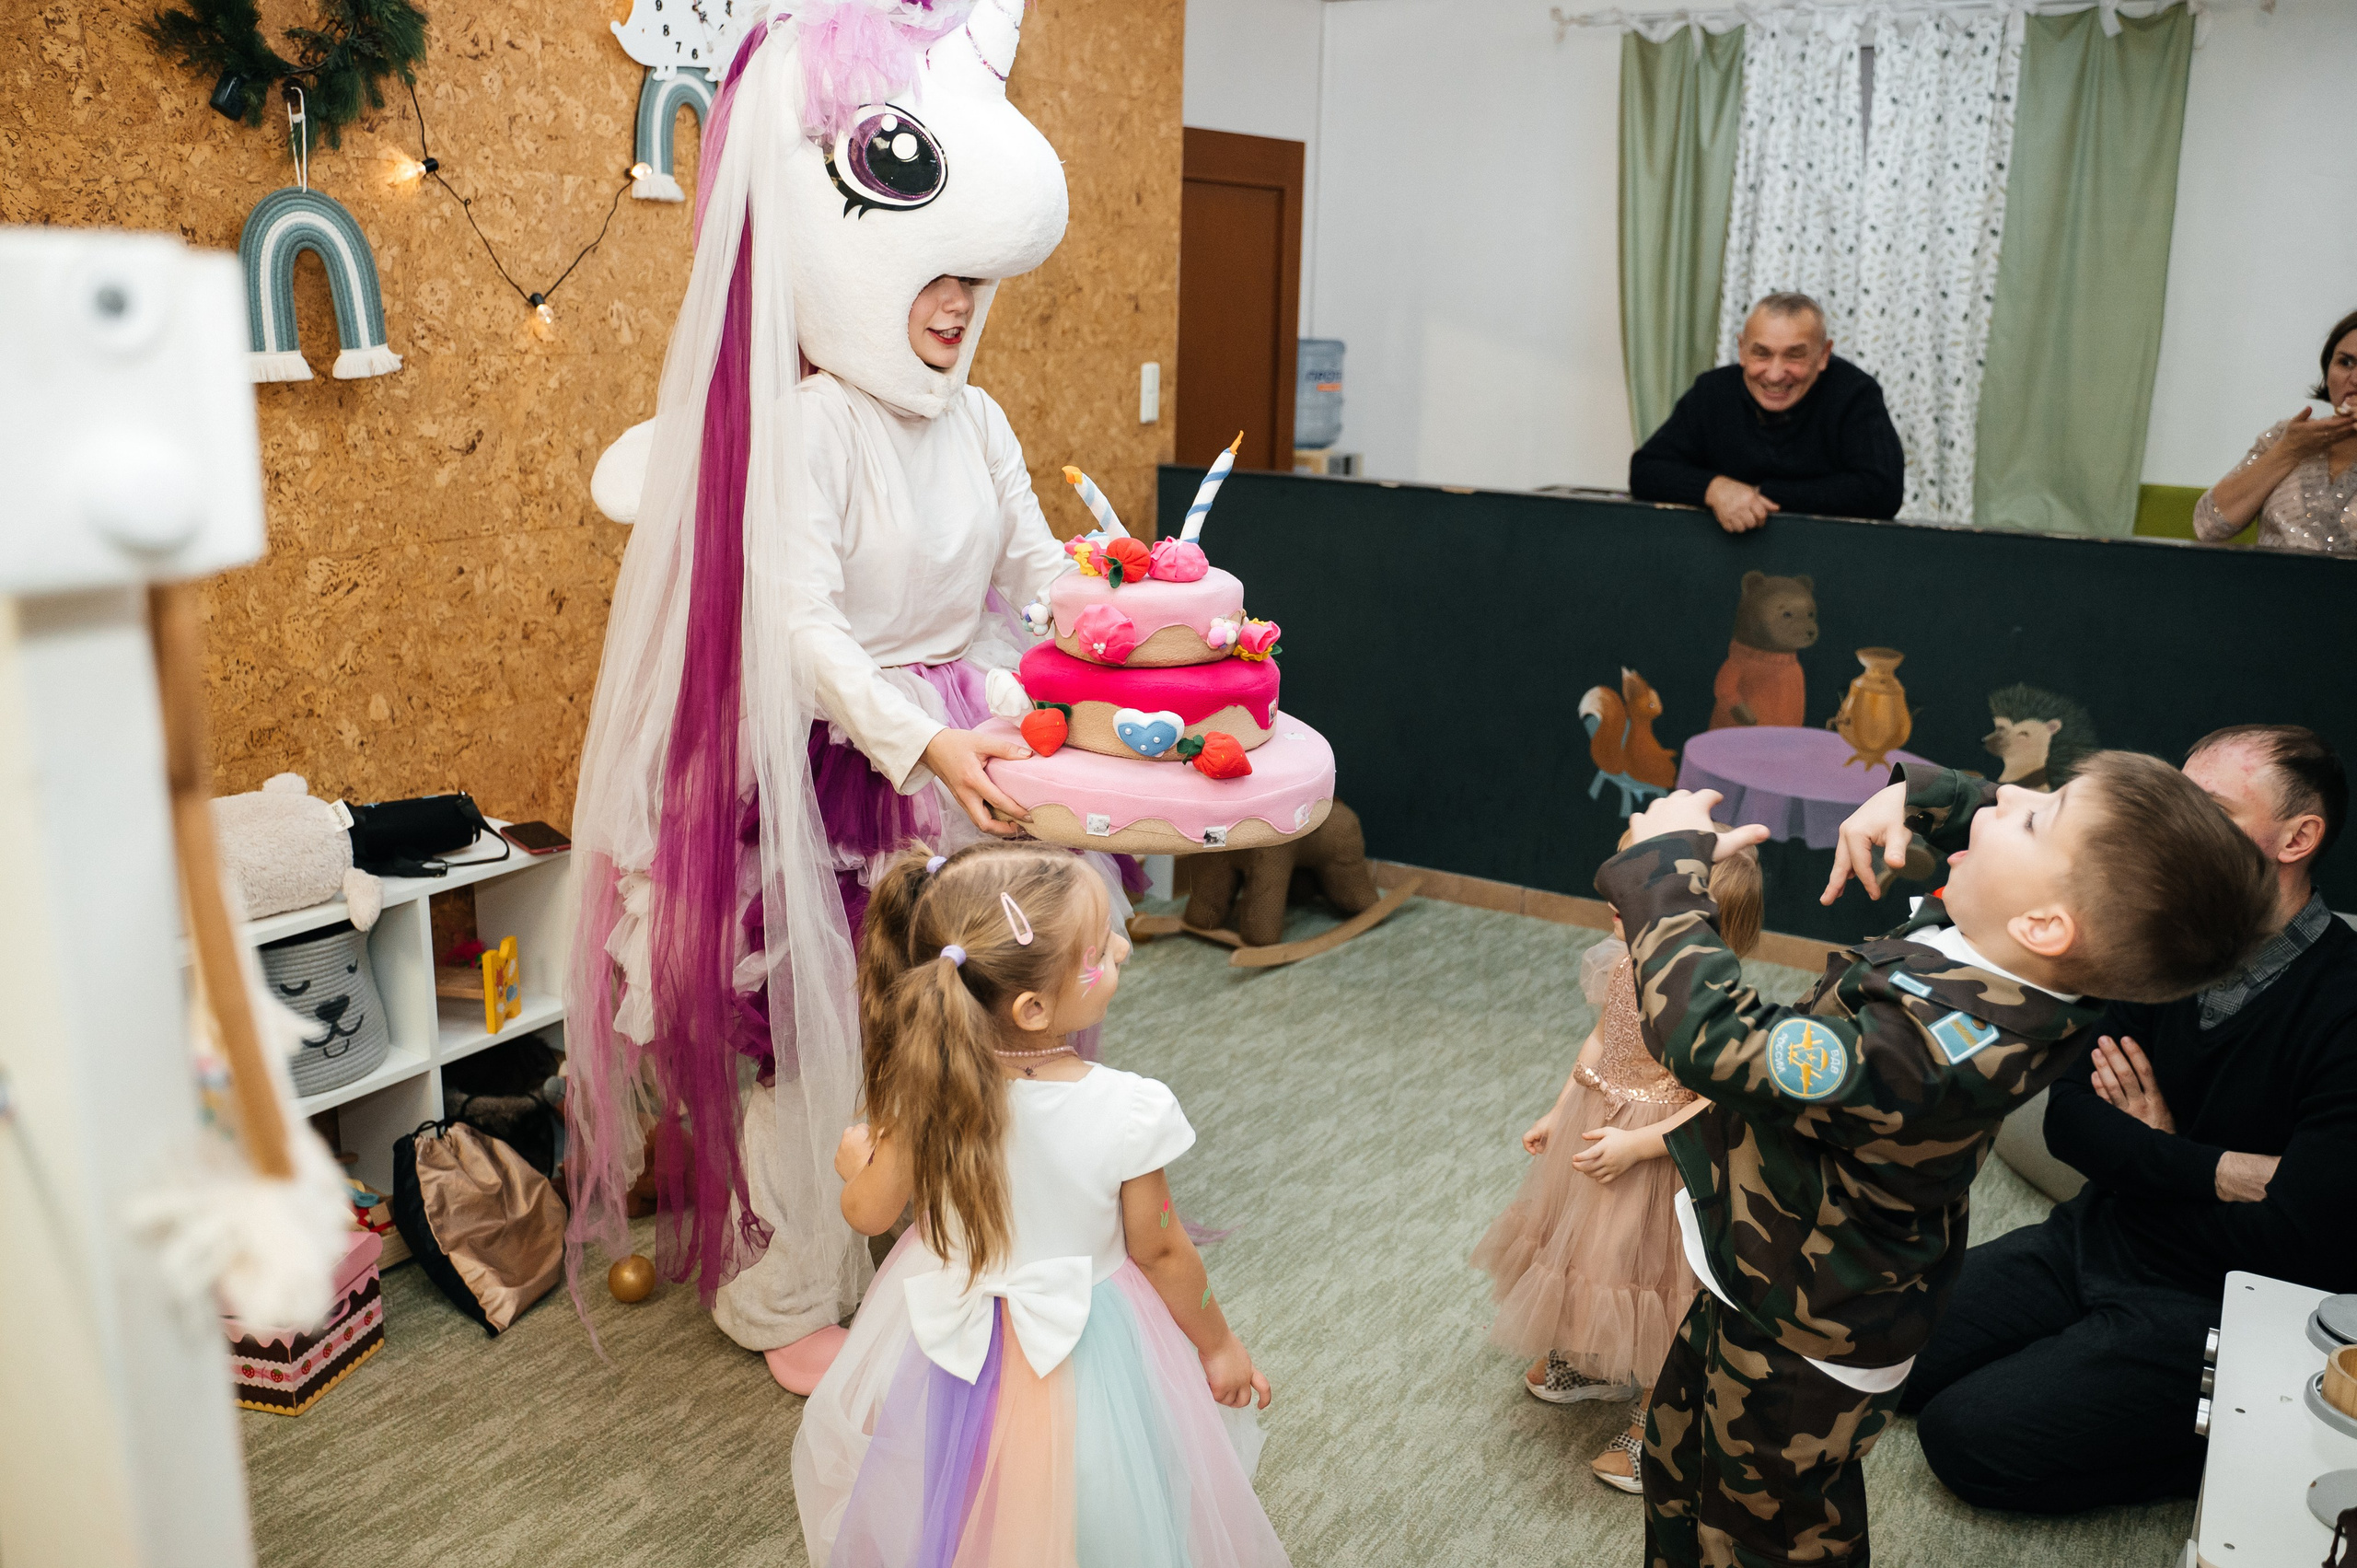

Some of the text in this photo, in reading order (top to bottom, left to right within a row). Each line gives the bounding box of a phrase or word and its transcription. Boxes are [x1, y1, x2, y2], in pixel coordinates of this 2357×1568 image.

[655, 0, 662, 11] 9
[663, 24, 669, 37] 8
[675, 41, 681, 53] 7
[691, 48, 699, 60] 6
[1774, 1033, 1789, 1074] РОССИИ
[1830, 1049, 1840, 1074] ВДВ
